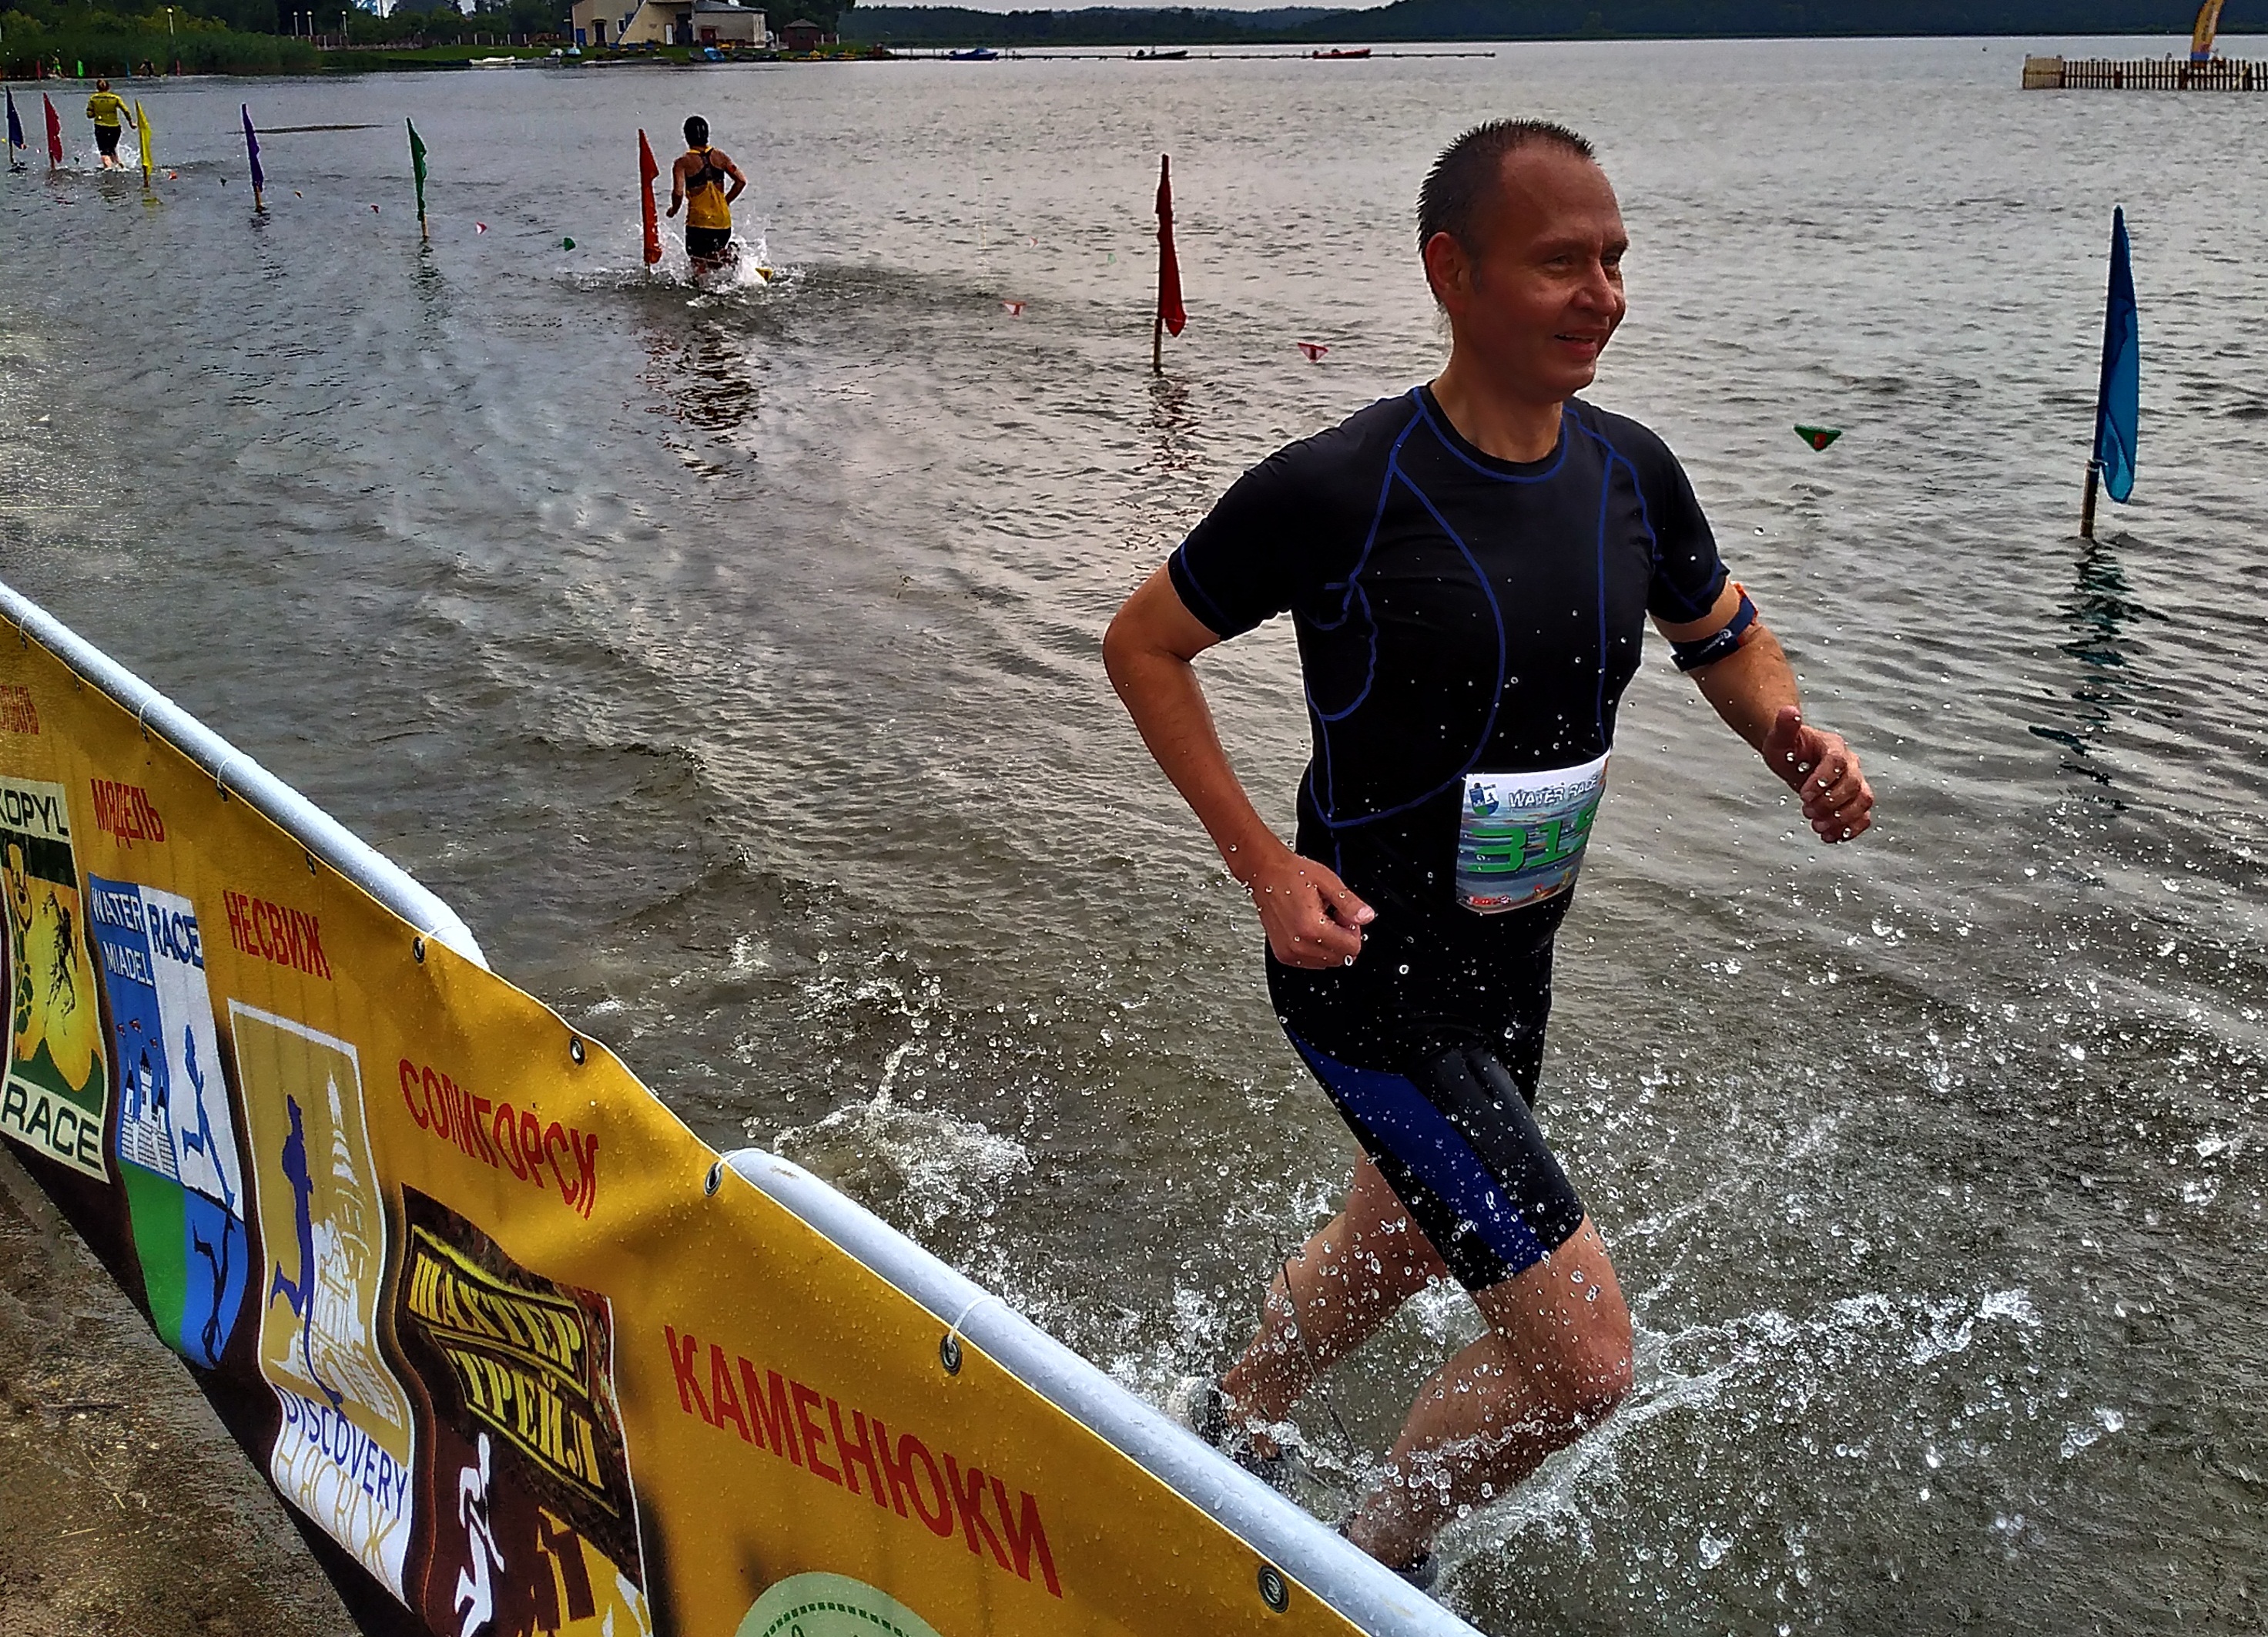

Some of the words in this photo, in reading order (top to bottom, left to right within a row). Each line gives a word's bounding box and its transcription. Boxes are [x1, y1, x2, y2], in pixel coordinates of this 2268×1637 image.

[1508, 787, 1564, 807] WATER
[91, 887, 146, 934] WATER
[148, 903, 205, 971] RACE
[102, 940, 154, 986] MIADEL
[223, 890, 332, 981] НЕСВИЖ
[2, 1083, 103, 1172] RACE
[272, 1382, 408, 1521] DISCOVERY
[664, 1325, 1062, 1599] КАМЕНЮКИ
